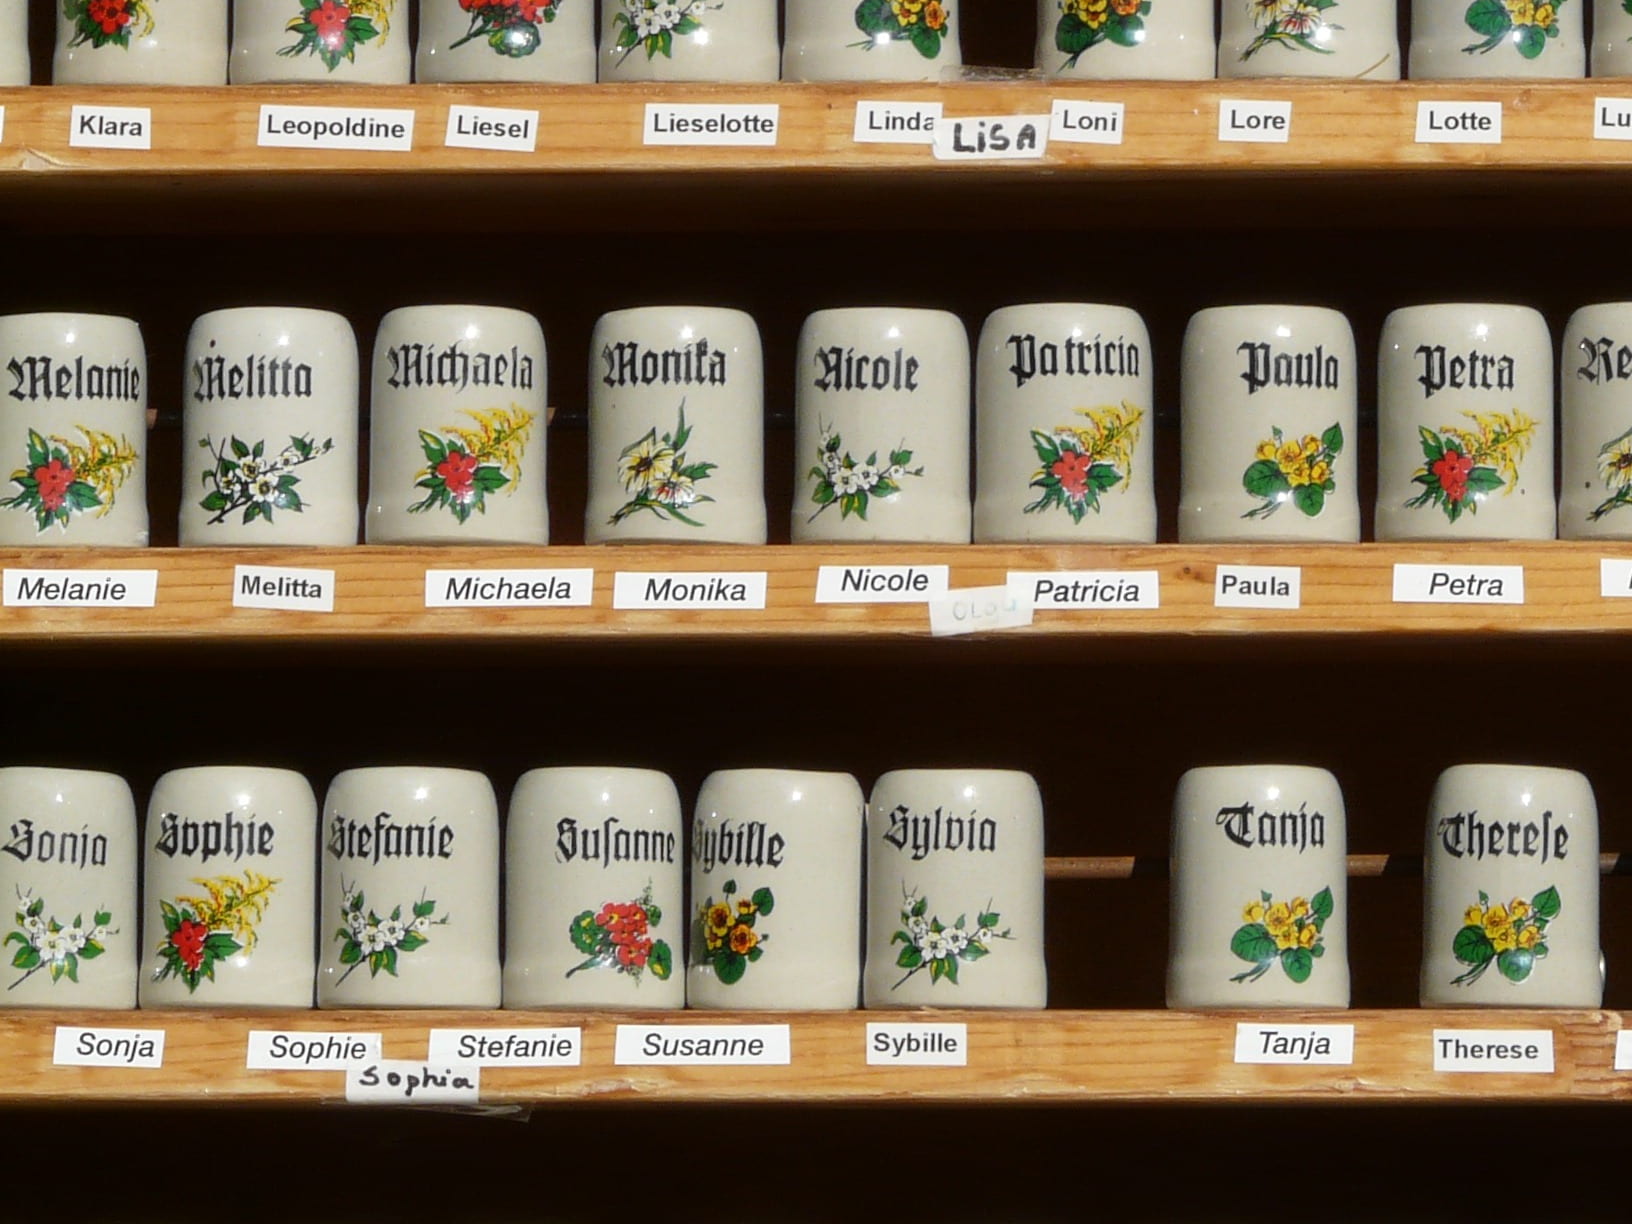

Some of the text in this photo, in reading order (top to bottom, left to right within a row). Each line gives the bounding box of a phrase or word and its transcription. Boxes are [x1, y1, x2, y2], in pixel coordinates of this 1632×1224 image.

[79, 115, 142, 137] Klara
[267, 114, 405, 141] Leopoldine
[457, 114, 529, 139] Liesel
[654, 113, 774, 133] Lieselotte
[869, 110, 934, 131] Linda
[1063, 109, 1117, 132] Loni
[1231, 109, 1286, 130] Lore
[1429, 110, 1492, 131] Lotte
[387, 342, 533, 390] Michaela
[601, 337, 726, 389] Monika
[1006, 333, 1140, 389] Patricia
[1236, 341, 1339, 395] Paula
[1415, 344, 1515, 399] Petra
[6, 355, 140, 402] Melanie
[192, 354, 312, 403] Melitta
[17, 577, 126, 601] Melanie
[241, 575, 322, 599] Melitta
[445, 576, 571, 600] Michaela
[644, 578, 746, 601] Monika
[841, 568, 929, 592] Nicole
[1034, 579, 1139, 603] Patricia
[1222, 574, 1290, 596] Paula
[1429, 572, 1503, 596] Petra
[154, 811, 275, 864] Sophie
[326, 811, 454, 866] Stefanie
[882, 804, 997, 861] Sylvia
[1215, 801, 1325, 854] Tanja
[0, 818, 108, 870] Sonja
[76, 1032, 155, 1063] Sonja
[269, 1034, 367, 1065] Sophie
[457, 1034, 572, 1058] Stefanie
[642, 1032, 764, 1057] Susanne
[874, 1032, 958, 1058] Sybille
[1259, 1031, 1330, 1061] Tanja
[1438, 1038, 1539, 1059] Therese
[358, 1065, 475, 1093] Sophia
